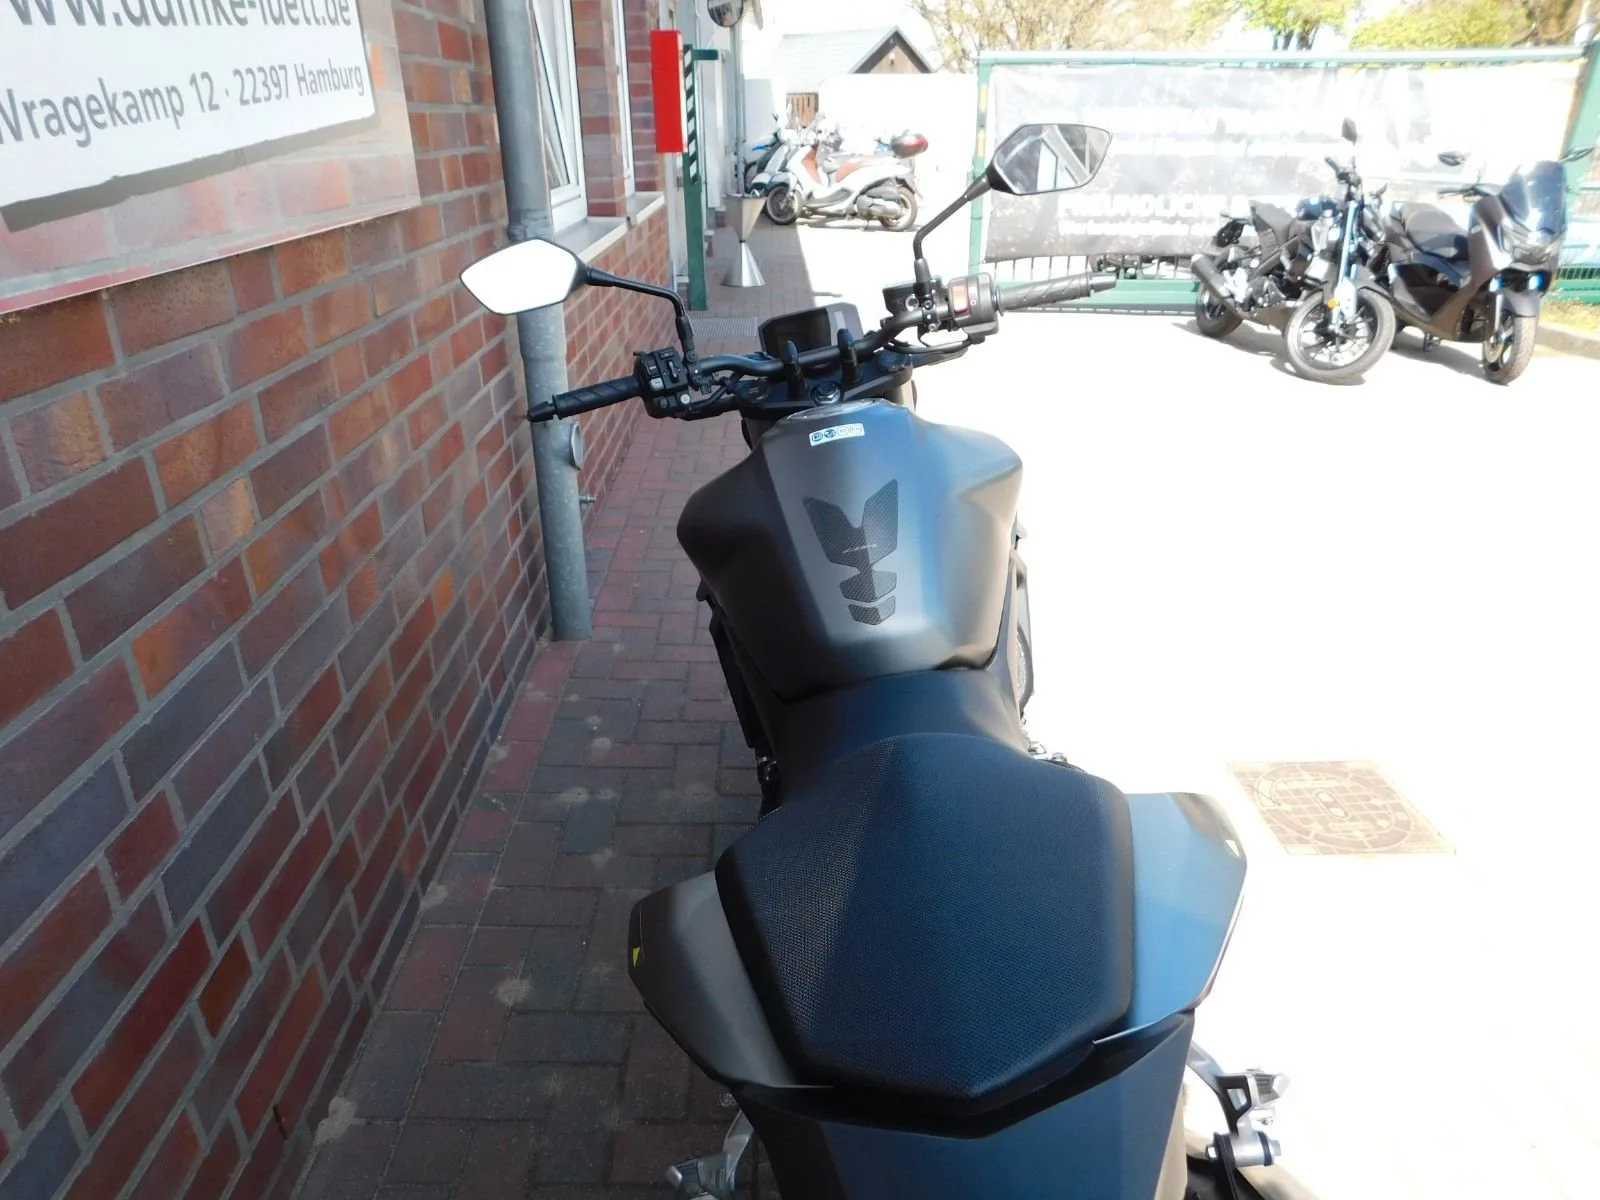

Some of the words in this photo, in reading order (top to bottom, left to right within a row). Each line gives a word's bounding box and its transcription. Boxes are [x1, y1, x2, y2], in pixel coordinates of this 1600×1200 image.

[189, 71, 220, 113] 12
[233, 64, 290, 107] 22397
[294, 58, 365, 97] Hamburg
